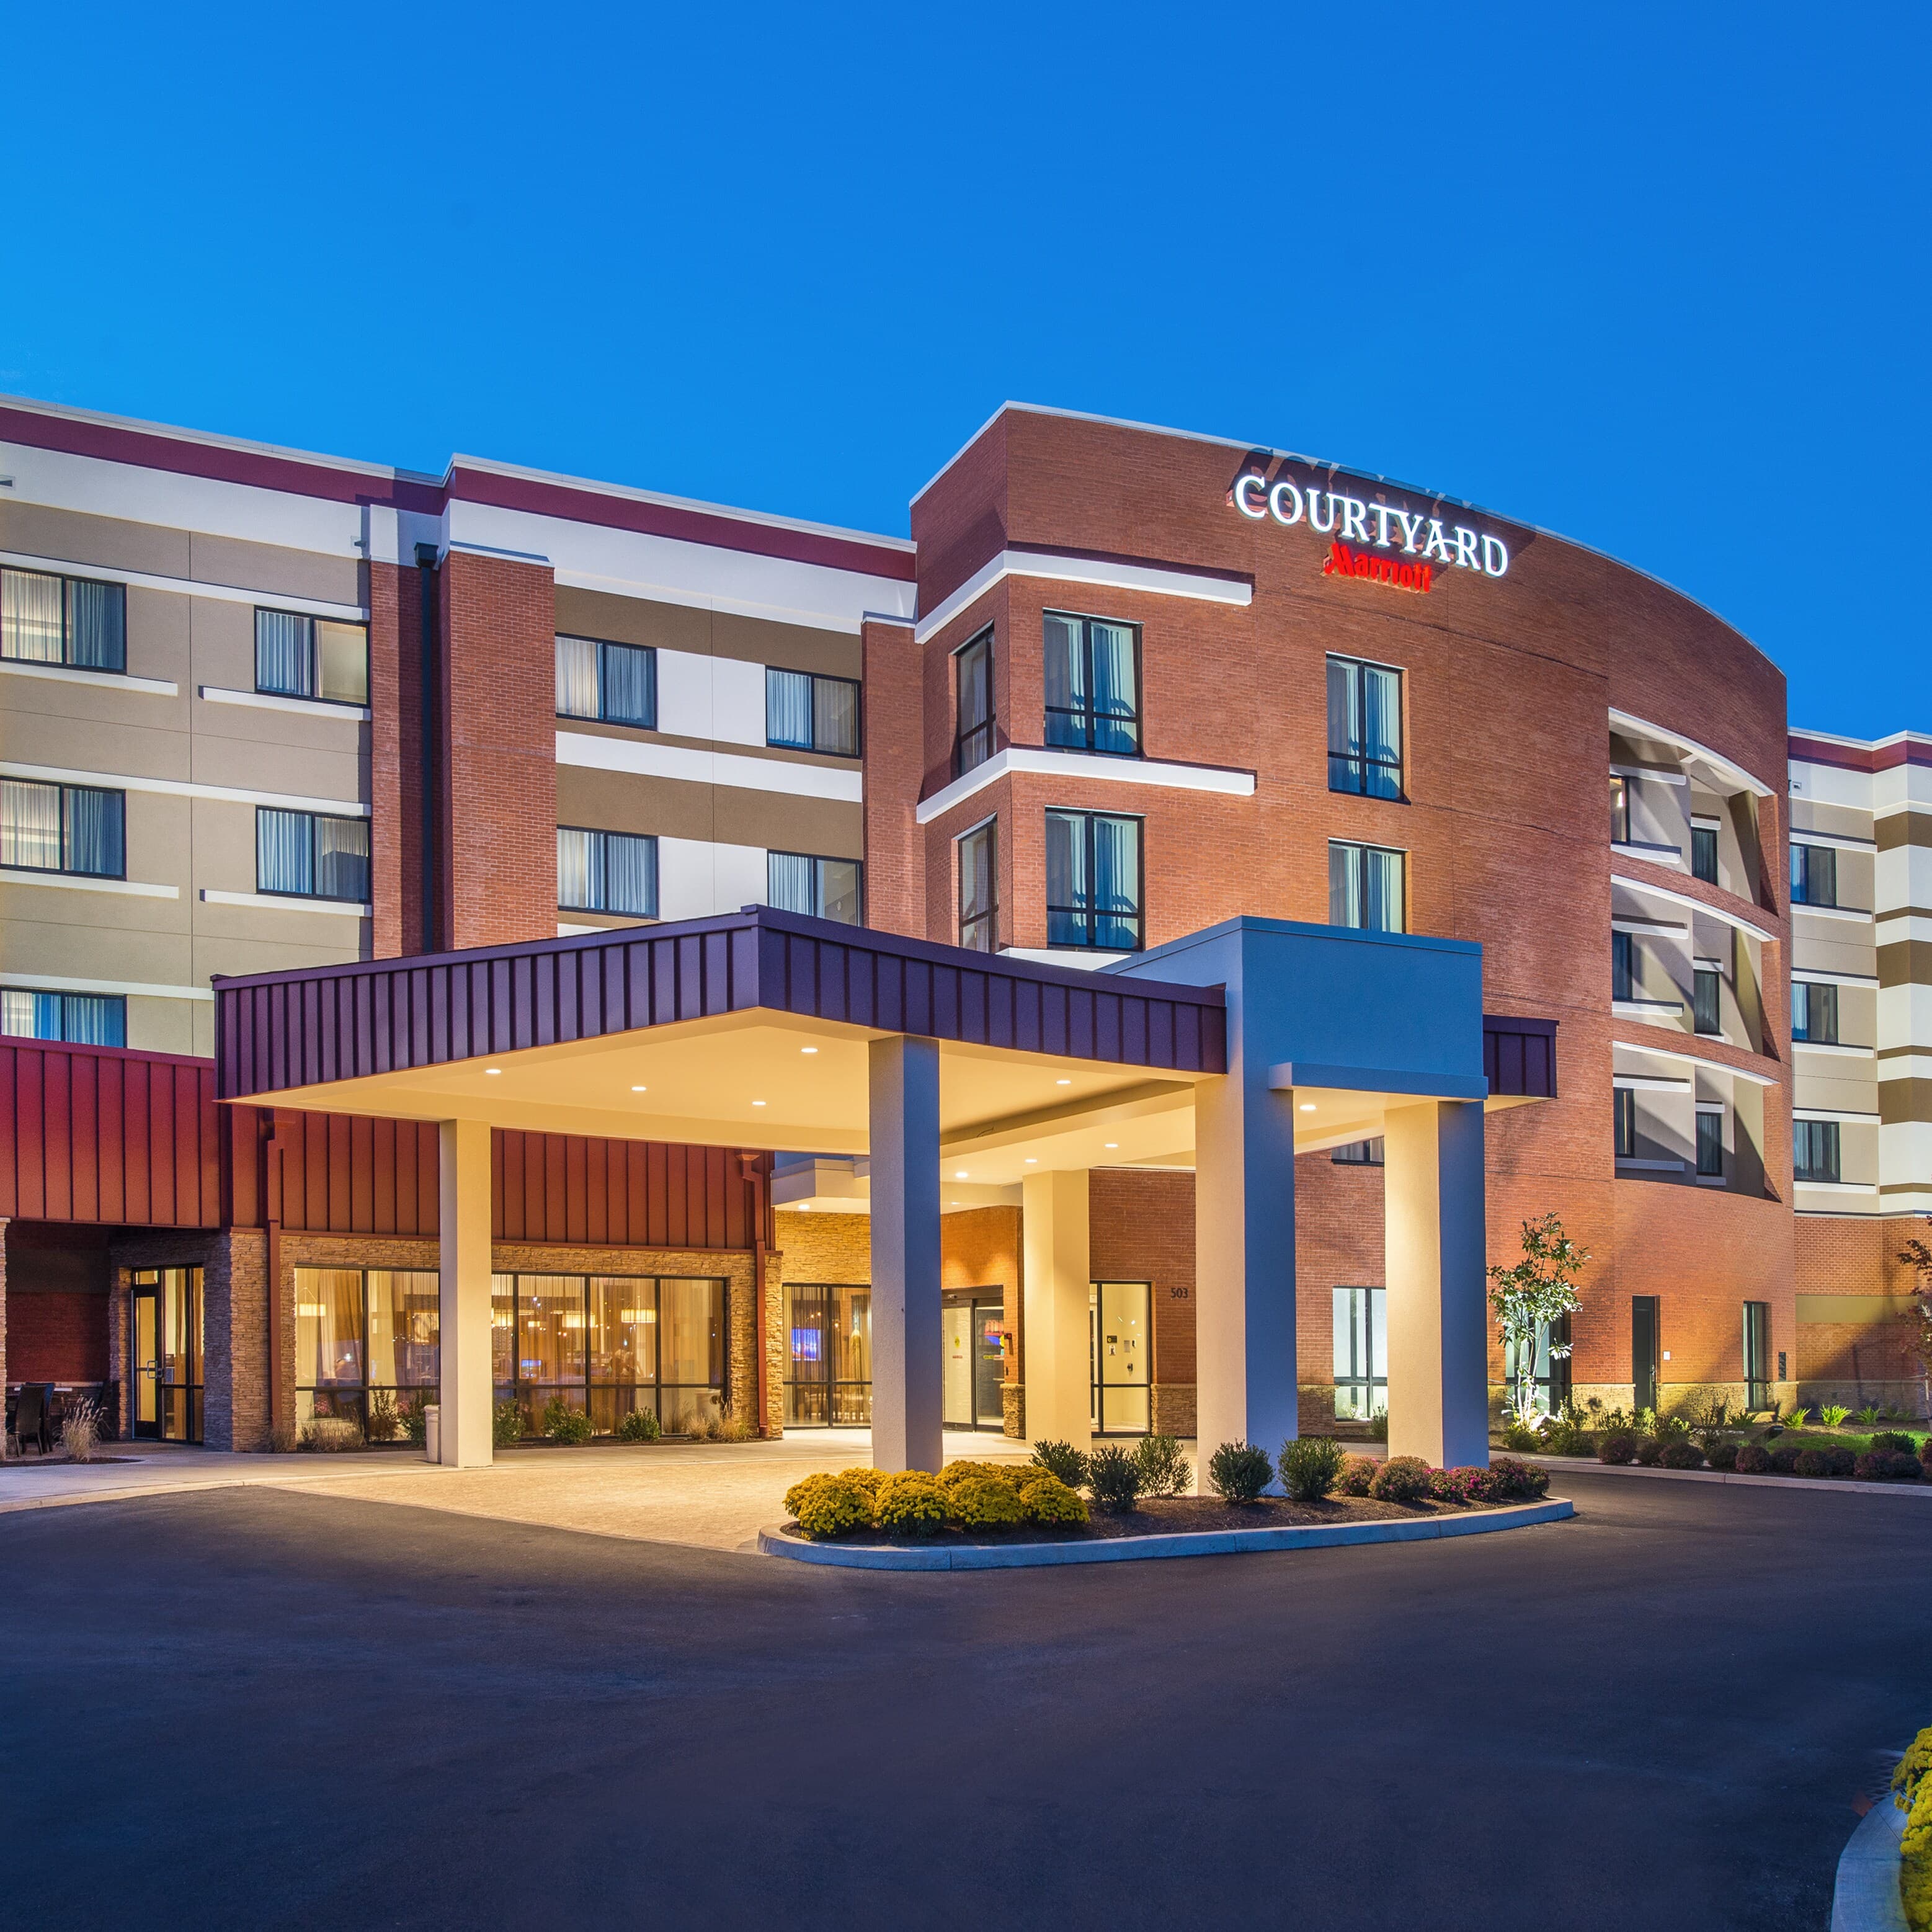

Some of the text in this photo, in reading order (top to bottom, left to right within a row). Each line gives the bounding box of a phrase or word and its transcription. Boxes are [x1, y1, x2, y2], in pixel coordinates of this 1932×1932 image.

[1235, 474, 1508, 577] COURTYARD
[1324, 543, 1432, 593] Marriott
[1170, 1287, 1188, 1298] 503
